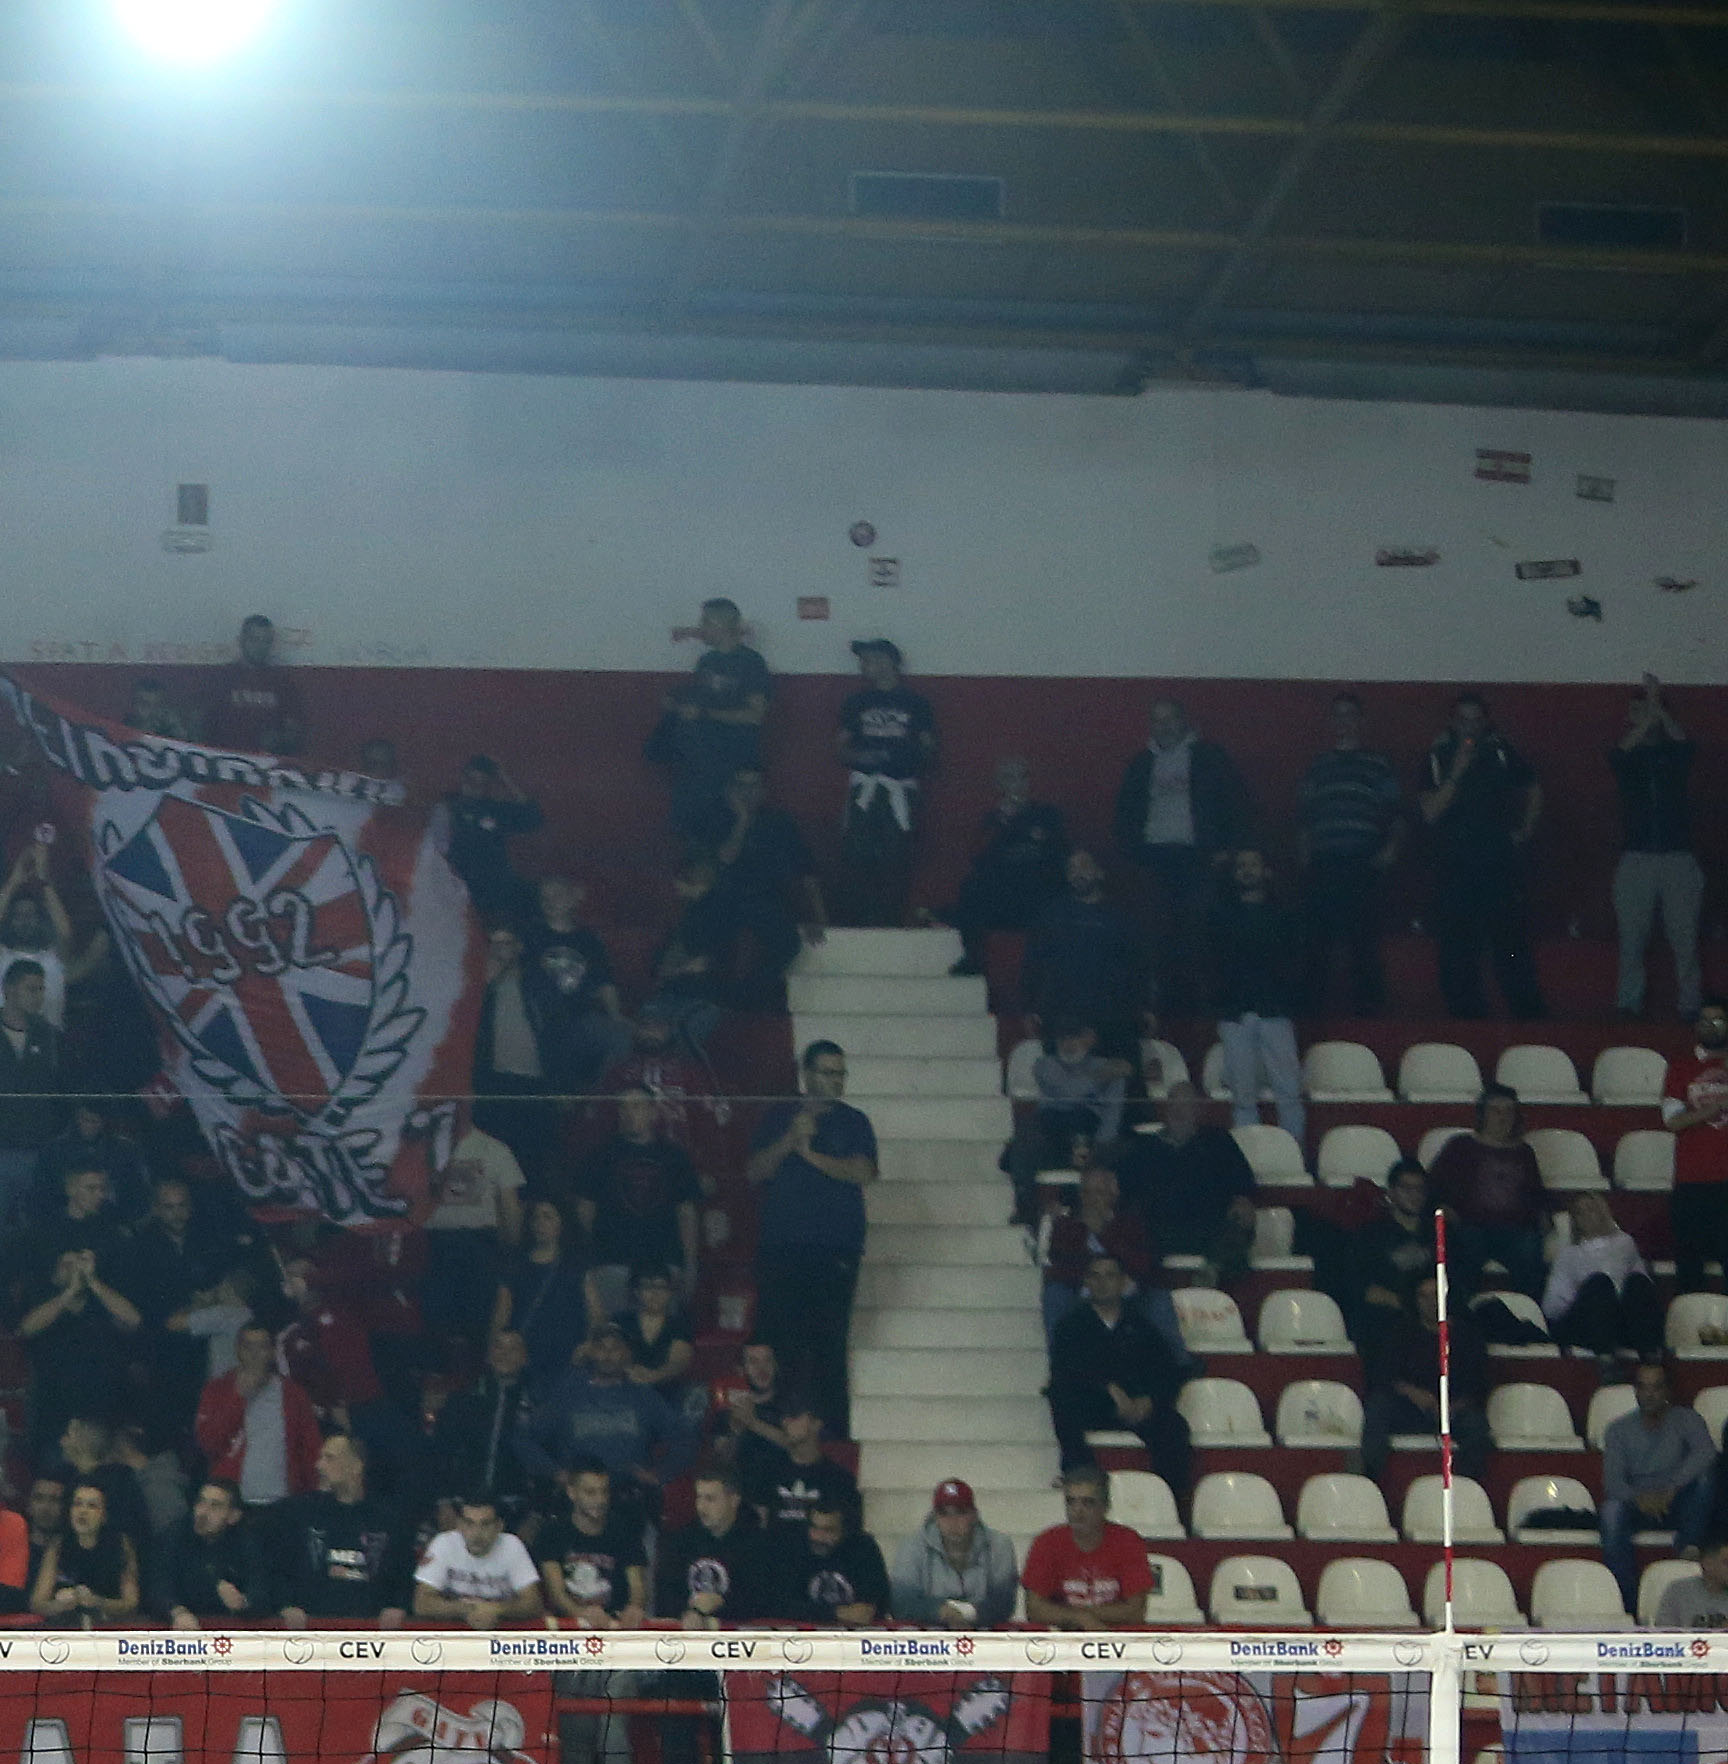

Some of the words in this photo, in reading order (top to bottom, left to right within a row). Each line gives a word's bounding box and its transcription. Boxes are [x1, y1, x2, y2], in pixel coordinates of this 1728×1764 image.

[118, 1640, 208, 1655] DenizBank
[339, 1642, 385, 1658] CEV
[490, 1640, 580, 1656] DenizBank
[711, 1643, 756, 1659] CEV
[861, 1641, 950, 1656] DenizBank
[1081, 1643, 1126, 1660] CEV
[1230, 1642, 1318, 1656] DenizBank
[1465, 1644, 1495, 1661] EV
[1597, 1642, 1685, 1657] DenizBank
